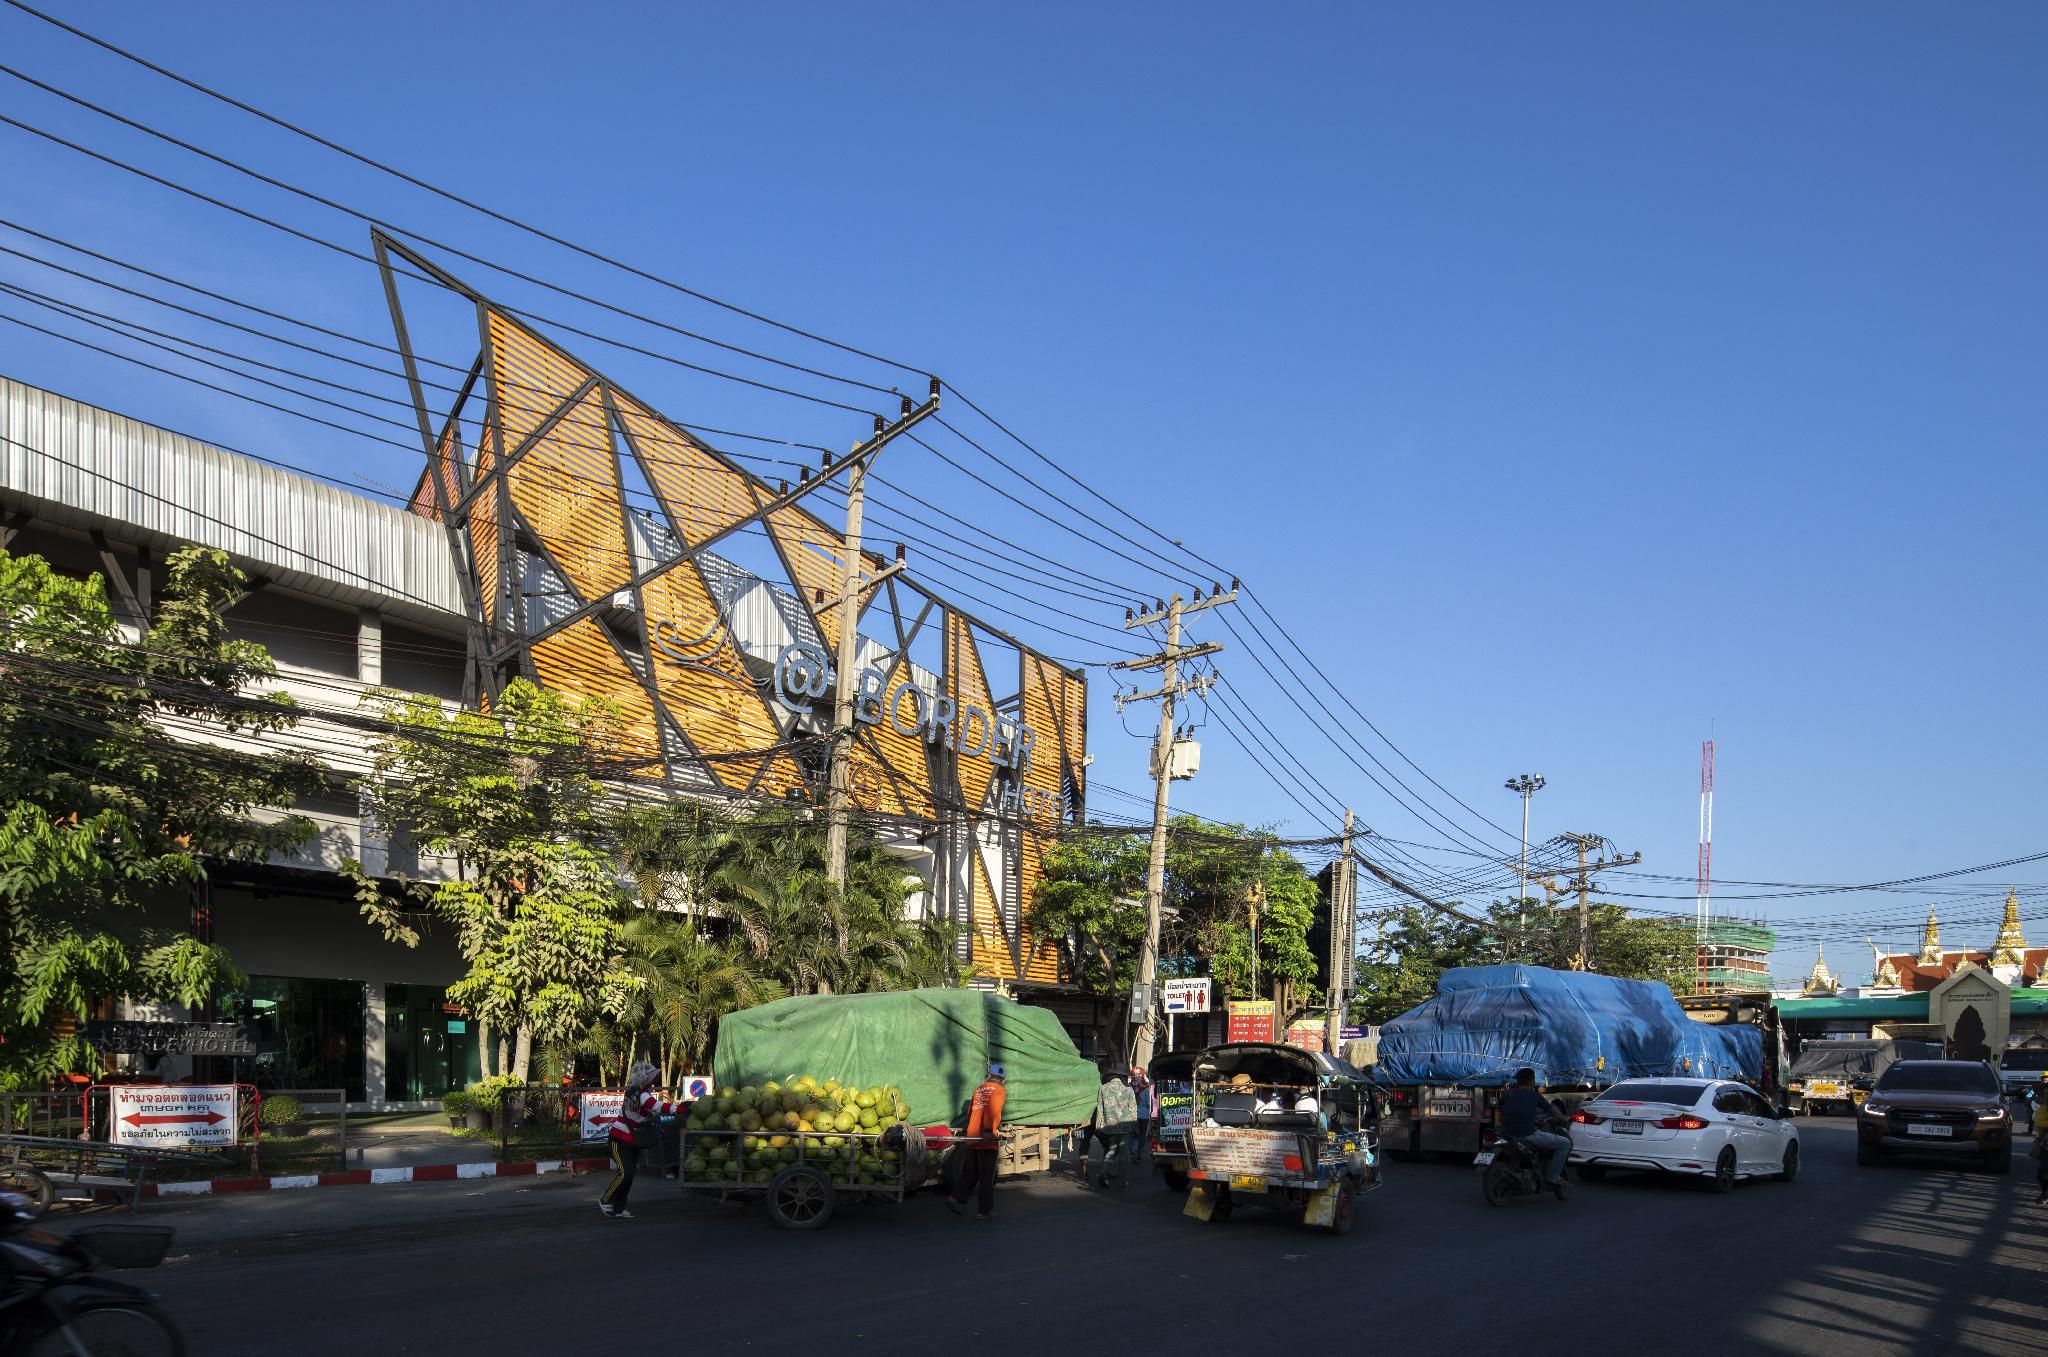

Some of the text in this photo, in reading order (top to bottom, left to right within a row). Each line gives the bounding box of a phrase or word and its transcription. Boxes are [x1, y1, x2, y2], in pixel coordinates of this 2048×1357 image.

[855, 667, 1037, 775] BORDER
[1001, 779, 1074, 824] HOTEL
[1167, 992, 1186, 1000] TOILET
[192, 1039, 252, 1053] HOTEL
[120, 1090, 231, 1103] ห้ามจอดตลอดแนว
[1432, 1101, 1471, 1113] รถพ่วง
[121, 1127, 231, 1138] ขออภัยในความไม่สะดวก
